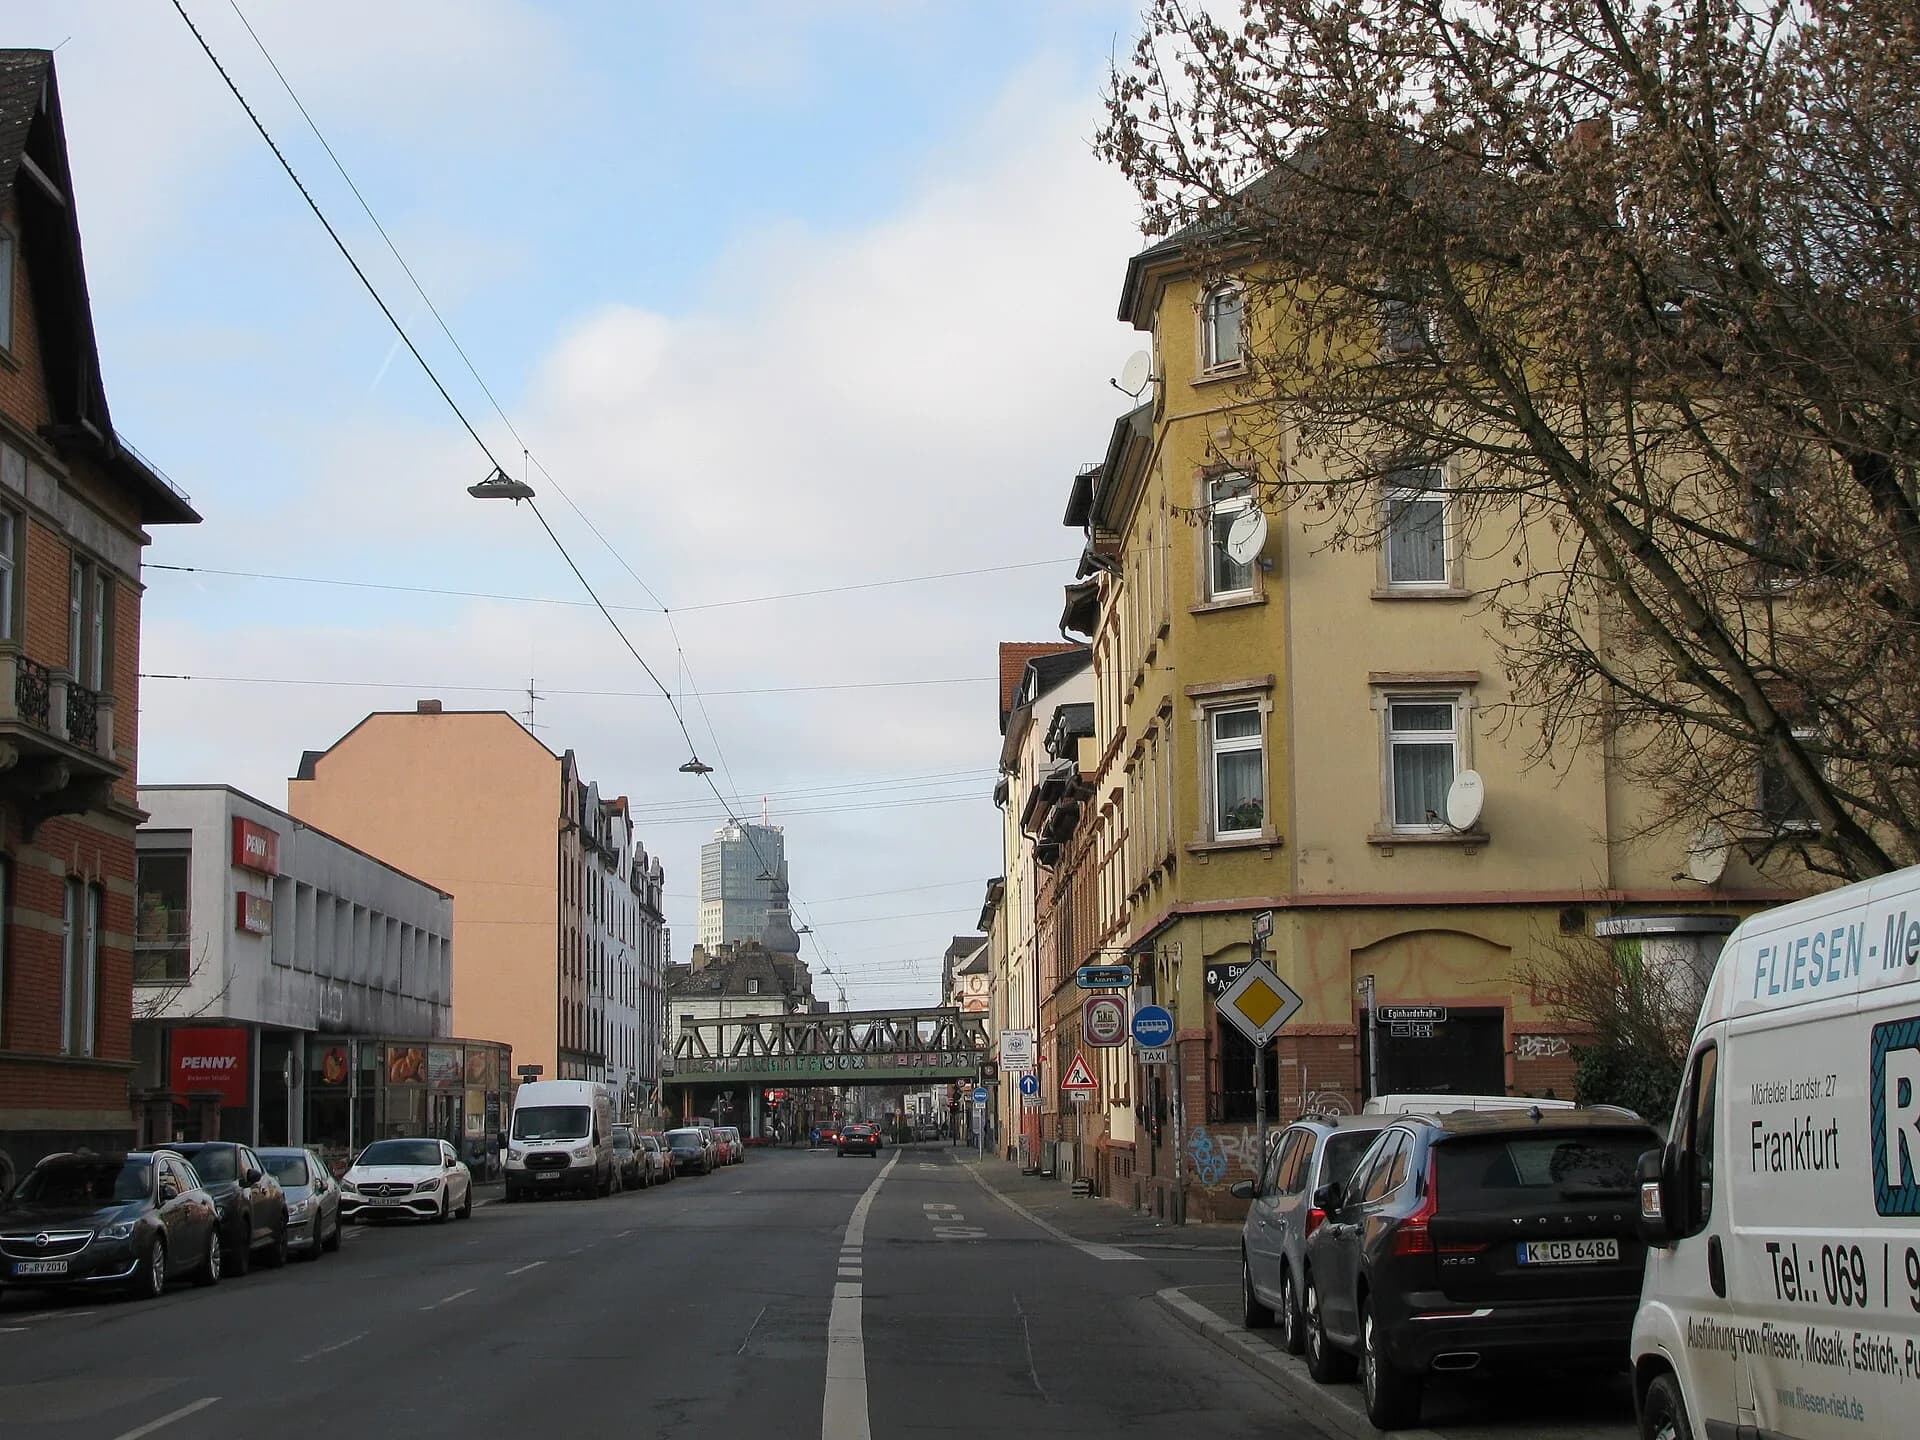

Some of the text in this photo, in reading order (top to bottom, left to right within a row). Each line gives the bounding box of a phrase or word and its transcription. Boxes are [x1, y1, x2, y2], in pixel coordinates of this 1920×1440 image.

[1753, 922, 1864, 999] FLIESEN
[1388, 1009, 1437, 1019] Eginhardstraße
[1142, 1052, 1166, 1061] TAXI
[1751, 1075, 1837, 1105] Mörfelder Landstr. 27
[1751, 1115, 1840, 1173] Frankfurt
[1512, 1214, 1622, 1225] VOLVO
[1528, 1241, 1616, 1261] K CB 6486
[1766, 1243, 1818, 1302] Tel.:
[1821, 1244, 1868, 1309] 069
[1687, 1315, 1737, 1361] Ausführung
[1805, 1327, 1851, 1376] Mosaik-,
[1853, 1332, 1903, 1384] Estrich-,
[1776, 1386, 1865, 1421] www.fliesen-ried.de
